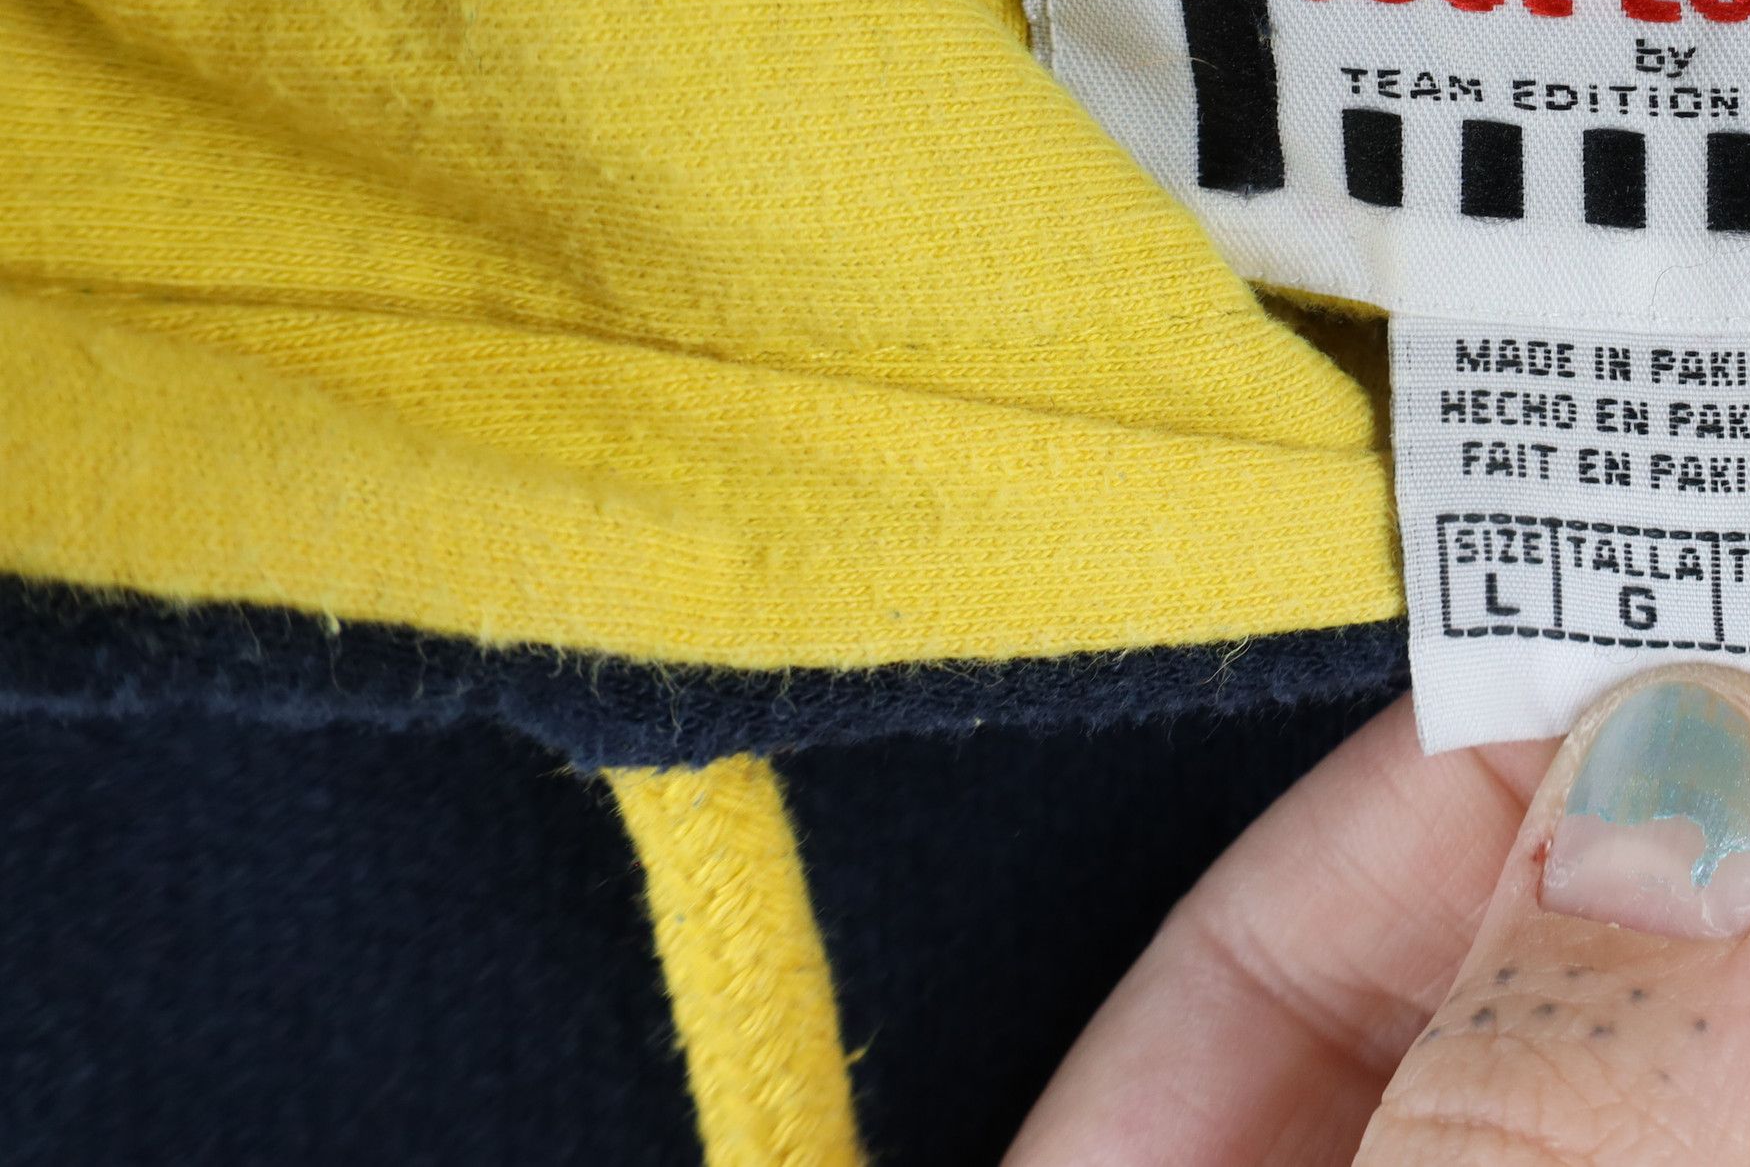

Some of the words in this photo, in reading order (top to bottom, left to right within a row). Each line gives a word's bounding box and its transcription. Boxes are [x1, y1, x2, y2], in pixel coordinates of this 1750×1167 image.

[1636, 39, 1696, 78] by
[1342, 67, 1483, 104] TEAM
[1512, 80, 1740, 118] EDITION
[1455, 338, 1576, 378] MADE
[1595, 346, 1631, 381] IN
[1440, 389, 1577, 430] HECHO
[1596, 398, 1648, 435] EN
[1462, 441, 1557, 480] FAIT
[1578, 448, 1631, 486] EN
[1455, 529, 1543, 565] SIZE
[1567, 535, 1703, 581] TALLA
[1486, 572, 1520, 616] L
[1618, 586, 1658, 630] G
